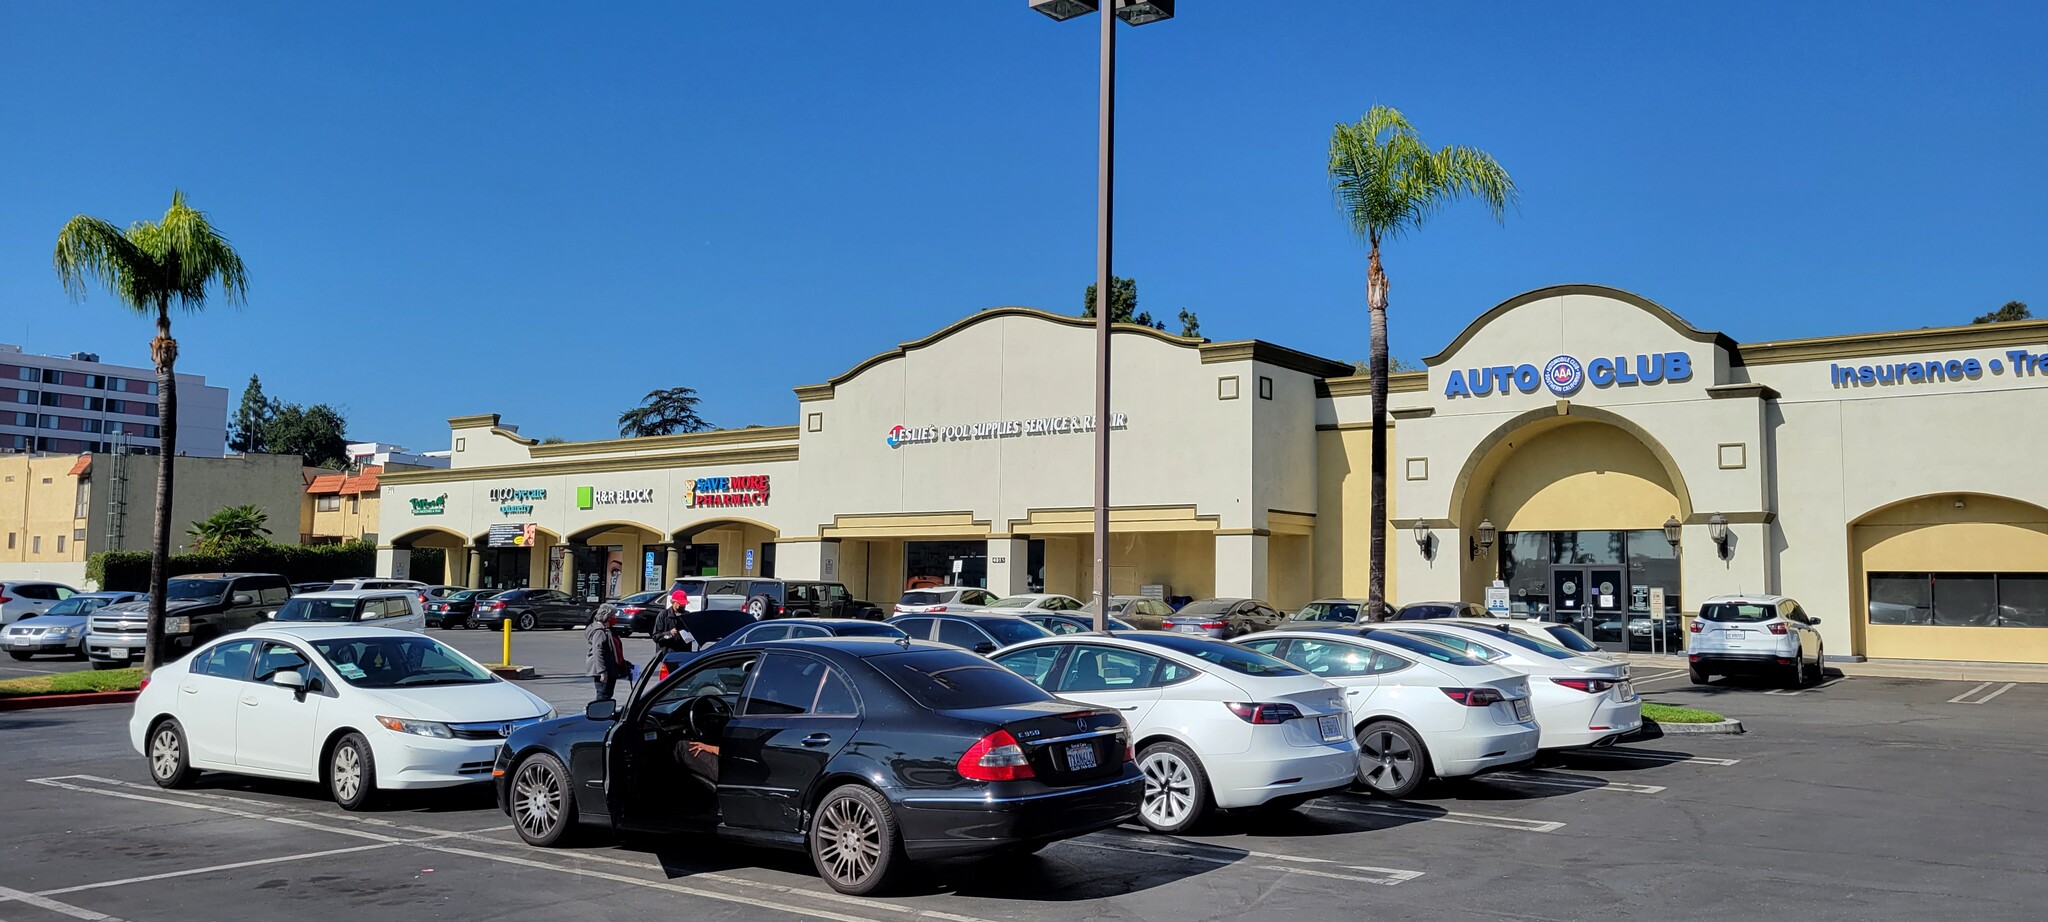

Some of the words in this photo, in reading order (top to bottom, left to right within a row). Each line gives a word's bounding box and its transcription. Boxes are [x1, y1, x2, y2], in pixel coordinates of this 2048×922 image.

[1444, 363, 1540, 396] AUTO
[1588, 352, 1691, 385] CLUB
[1554, 368, 1572, 379] AAA
[1830, 358, 1982, 385] Insurance
[940, 425, 969, 439] POOL
[972, 420, 1020, 437] SUPPLIES
[1024, 417, 1068, 433] SERVICE
[1071, 416, 1081, 429] &
[696, 478, 728, 491] SAVE
[730, 475, 768, 491] MORE
[595, 490, 616, 502] H&R
[618, 489, 651, 501] BLOCK
[697, 492, 768, 506] PHARMACY
